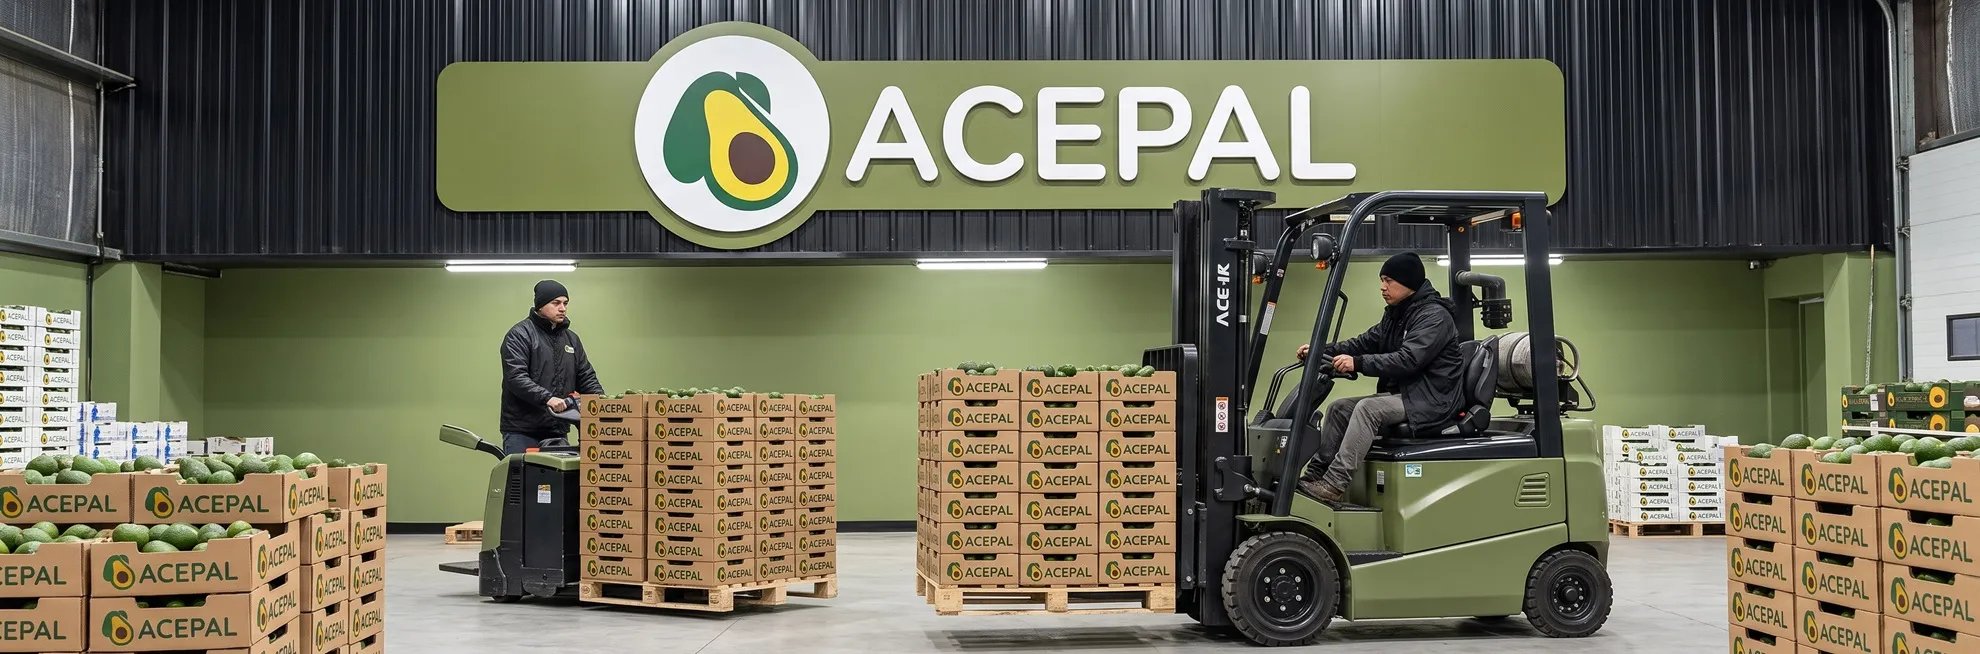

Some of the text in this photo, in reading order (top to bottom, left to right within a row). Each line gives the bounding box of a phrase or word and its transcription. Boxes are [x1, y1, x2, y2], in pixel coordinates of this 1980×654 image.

[844, 84, 1357, 182] ACEPAL
[966, 383, 1013, 392] ACEPAL
[1045, 384, 1092, 394] ACEPAL
[1123, 384, 1170, 394] ACEPAL
[599, 404, 632, 413] ACEPAL
[668, 404, 702, 413] ACEPAL
[966, 414, 1013, 423] ACEPAL
[1045, 415, 1092, 424] ACEPAL
[1124, 414, 1170, 424] ACEPAL
[599, 427, 632, 436] ACEPAL
[668, 428, 703, 436] ACEPAL
[727, 427, 752, 435] ACEPAL
[769, 427, 793, 435] ACEPAL
[769, 450, 792, 458] ACEPAL
[809, 449, 833, 457] ACEPAL
[966, 444, 1013, 454] ACEPAL
[1045, 445, 1092, 455] ACEPAL
[1124, 445, 1170, 454] ACEPAL
[599, 450, 632, 459] ACEPAL
[668, 452, 703, 460] ACEPAL
[727, 451, 752, 459] ACEPAL
[599, 473, 632, 482] ACEPAL
[668, 475, 702, 484] ACEPAL
[727, 474, 752, 483] ACEPAL
[769, 473, 792, 481] ACEPAL
[809, 472, 833, 480] ACEPAL
[965, 475, 1013, 485] ACEPAL
[1045, 476, 1092, 486] ACEPAL
[1123, 475, 1170, 484] ACEPAL
[1743, 467, 1784, 485] ACEPAL
[1818, 473, 1868, 494] ACEPAL
[362, 483, 384, 500] ACEPAL
[1910, 479, 1972, 503] ACEPAL
[299, 487, 324, 506] ACEPAL
[599, 496, 632, 506] ACEPAL
[769, 496, 793, 505] ACEPAL
[809, 494, 834, 502] ACEPAL
[27, 495, 117, 513] ACEPAL
[178, 495, 269, 513] ACEPAL
[668, 499, 703, 508] ACEPAL
[727, 498, 752, 507] ACEPAL
[965, 505, 1013, 515] ACEPAL
[1045, 506, 1092, 516] ACEPAL
[1123, 505, 1170, 515] ACEPAL
[599, 519, 632, 529] ACEPAL
[769, 519, 793, 528] ACEPAL
[809, 516, 834, 525] ACEPAL
[1744, 513, 1786, 533] ACEPAL
[668, 522, 703, 532] ACEPAL
[727, 521, 752, 531] ACEPAL
[324, 530, 346, 549] ACEPAL
[362, 526, 383, 543] ACEPAL
[1819, 524, 1868, 547] ACEPAL
[809, 539, 834, 548] ACEPAL
[965, 536, 1013, 546] ACEPAL
[1044, 537, 1092, 547] ACEPAL
[1123, 536, 1170, 545] ACEPAL
[599, 543, 632, 552] ACEPAL
[668, 546, 703, 556] ACEPAL
[727, 545, 752, 554] ACEPAL
[769, 542, 793, 551] ACEPAL
[1910, 535, 1973, 563] ACEPAL
[269, 541, 296, 567] ACEPAL
[599, 565, 632, 576] ACEPAL
[769, 565, 793, 574] ACEPAL
[809, 562, 834, 571] ACEPAL
[1123, 566, 1170, 576] ACEPAL
[1745, 558, 1786, 581] ACEPAL
[0, 566, 66, 585] EPAL
[139, 562, 238, 583] ACEPAL
[362, 568, 382, 585] ACEPAL
[667, 570, 702, 581] ACEPAL
[727, 569, 752, 578] ACEPAL
[965, 567, 1013, 577] ACEPAL
[1045, 567, 1092, 577] ACEPAL
[325, 576, 346, 595] ACEPAL
[1819, 574, 1869, 600] ACEPAL
[269, 591, 296, 619] ACEPAL
[1912, 592, 1974, 622] ACEPAL
[361, 609, 381, 630] ACEPAL
[1746, 603, 1787, 629] ACEPAL
[0, 621, 66, 640] EPAL
[138, 617, 237, 639] ACEPAL
[324, 621, 345, 643] ACEPAL
[1820, 624, 1871, 653] ACEPAL
